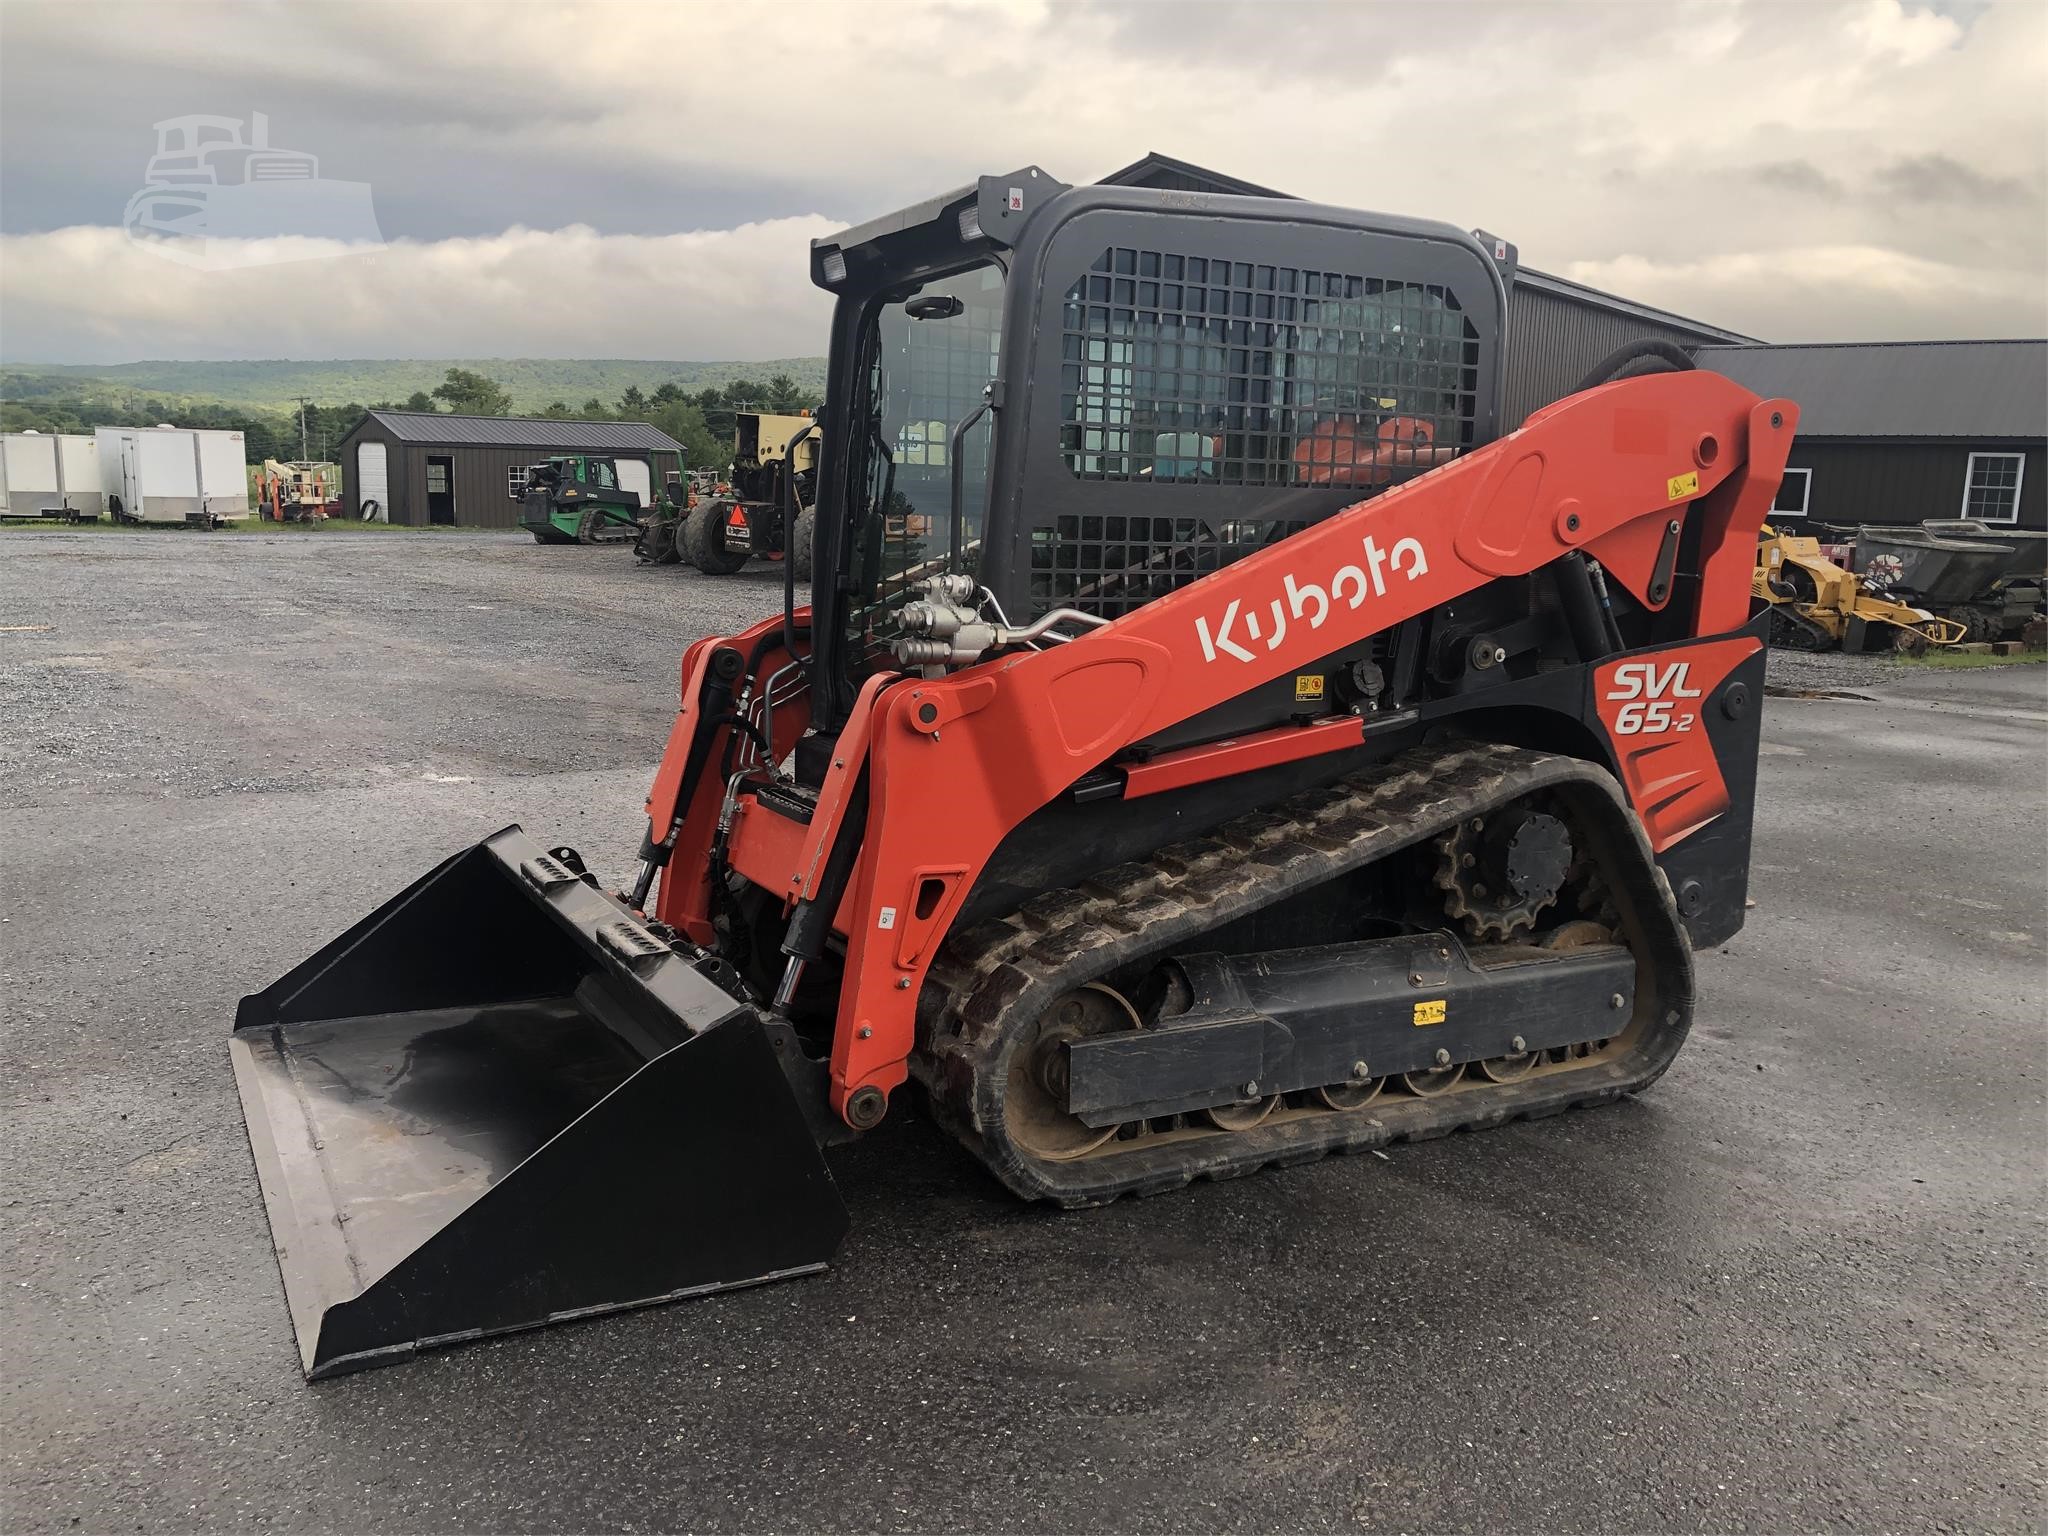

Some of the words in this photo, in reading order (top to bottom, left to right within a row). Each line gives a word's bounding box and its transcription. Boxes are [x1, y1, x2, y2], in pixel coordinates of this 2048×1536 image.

[1194, 535, 1429, 663] Kubota
[1606, 662, 1702, 700] SVL
[1615, 702, 1695, 735] 65-2
